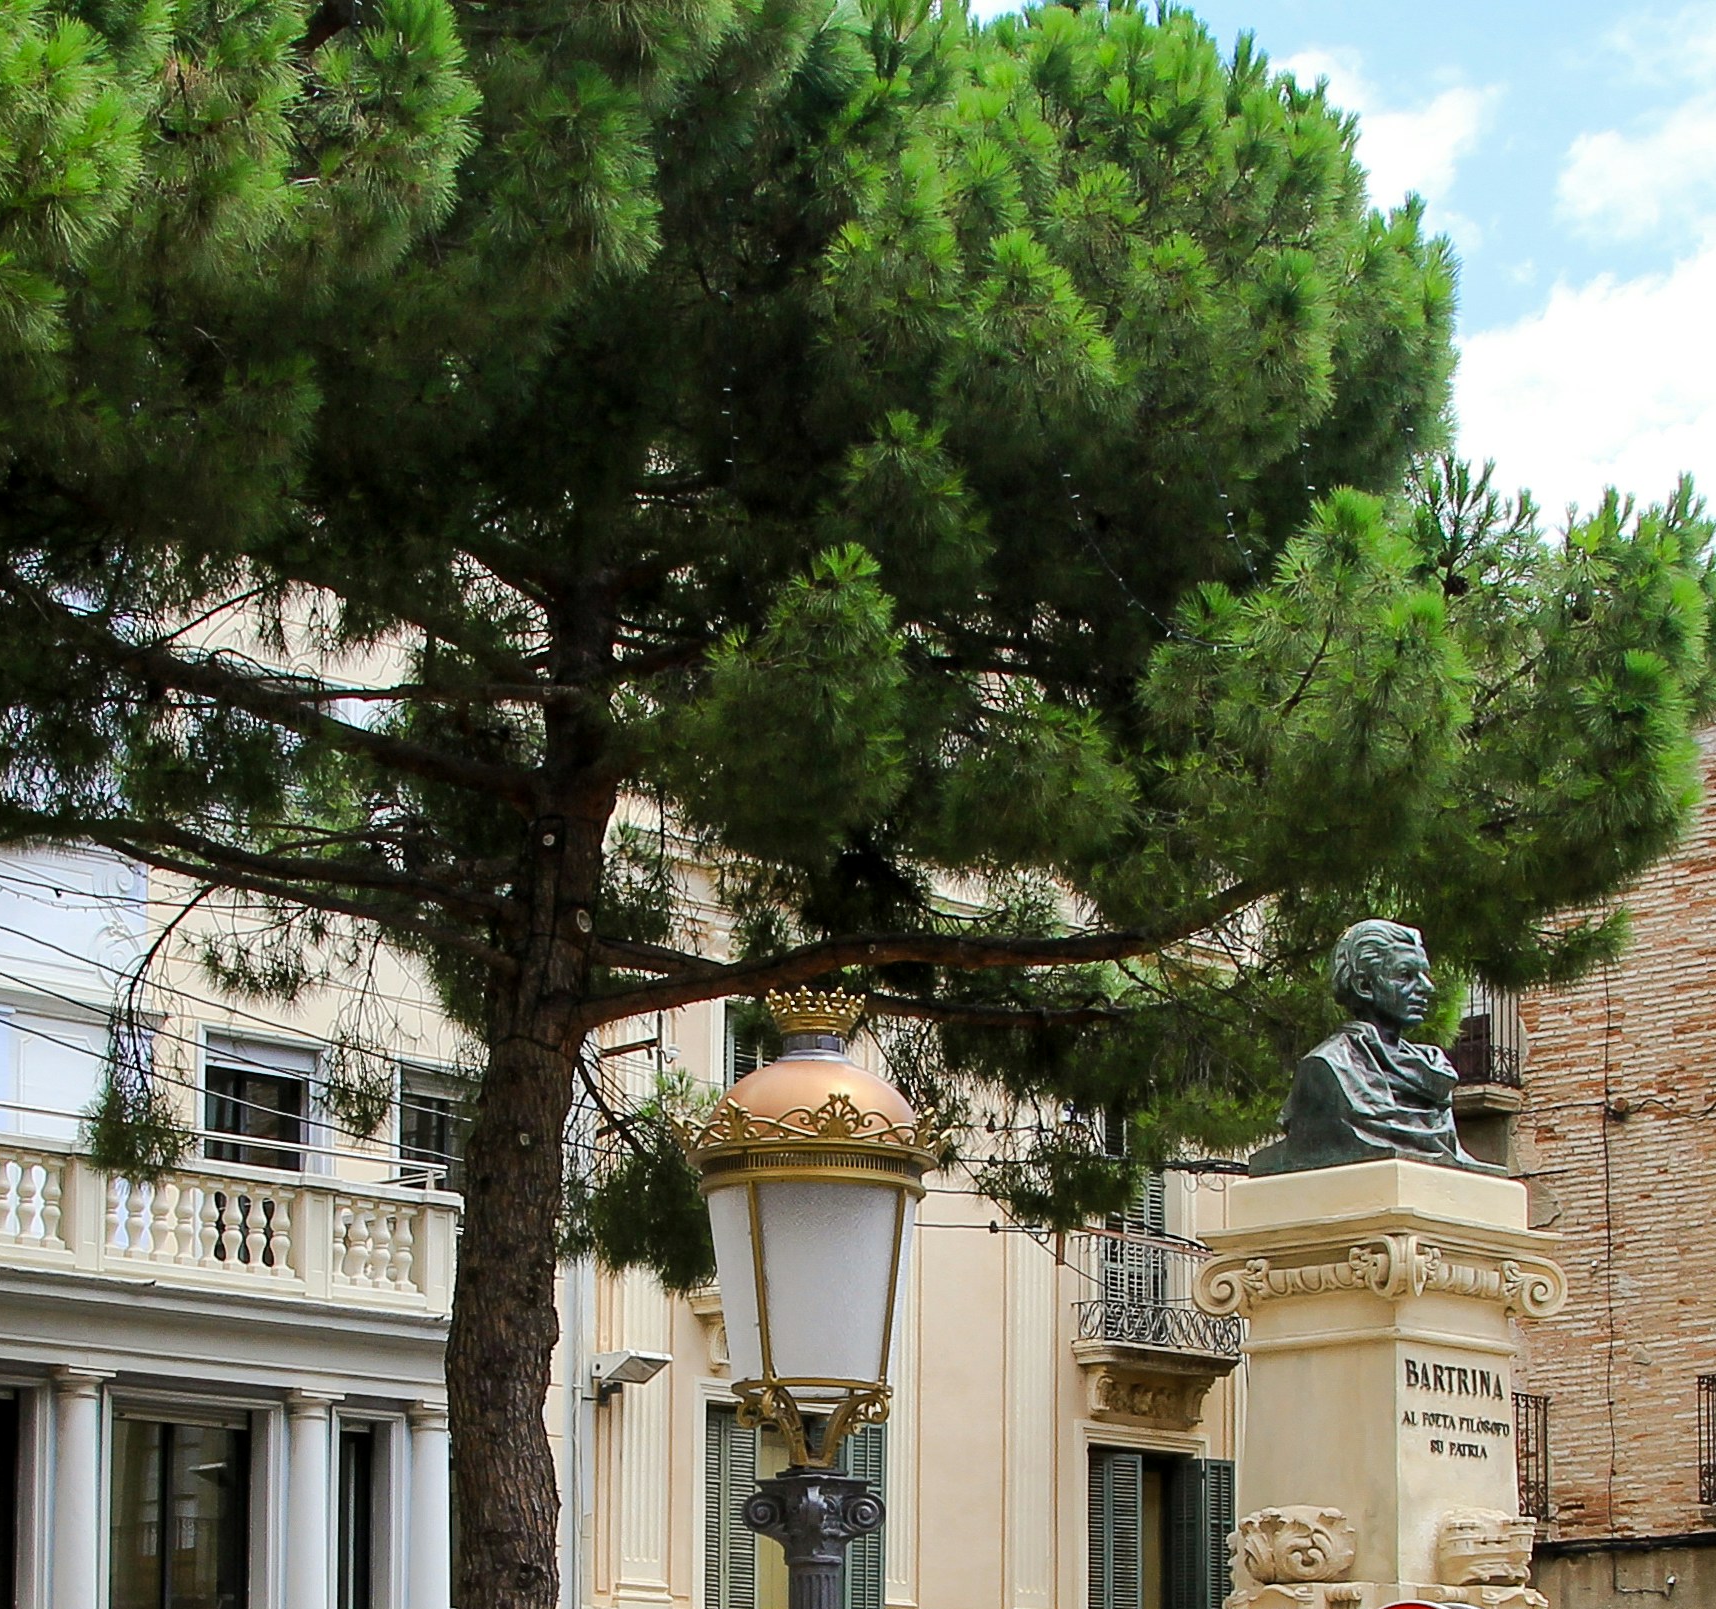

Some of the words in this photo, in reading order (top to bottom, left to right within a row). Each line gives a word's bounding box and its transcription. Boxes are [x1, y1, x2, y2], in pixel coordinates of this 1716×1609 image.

[1405, 1359, 1503, 1400] BARTRINA
[1402, 1410, 1417, 1427] AL
[1422, 1412, 1456, 1432] POETA
[1430, 1439, 1443, 1454] SU
[1449, 1441, 1488, 1459] PATRIA
